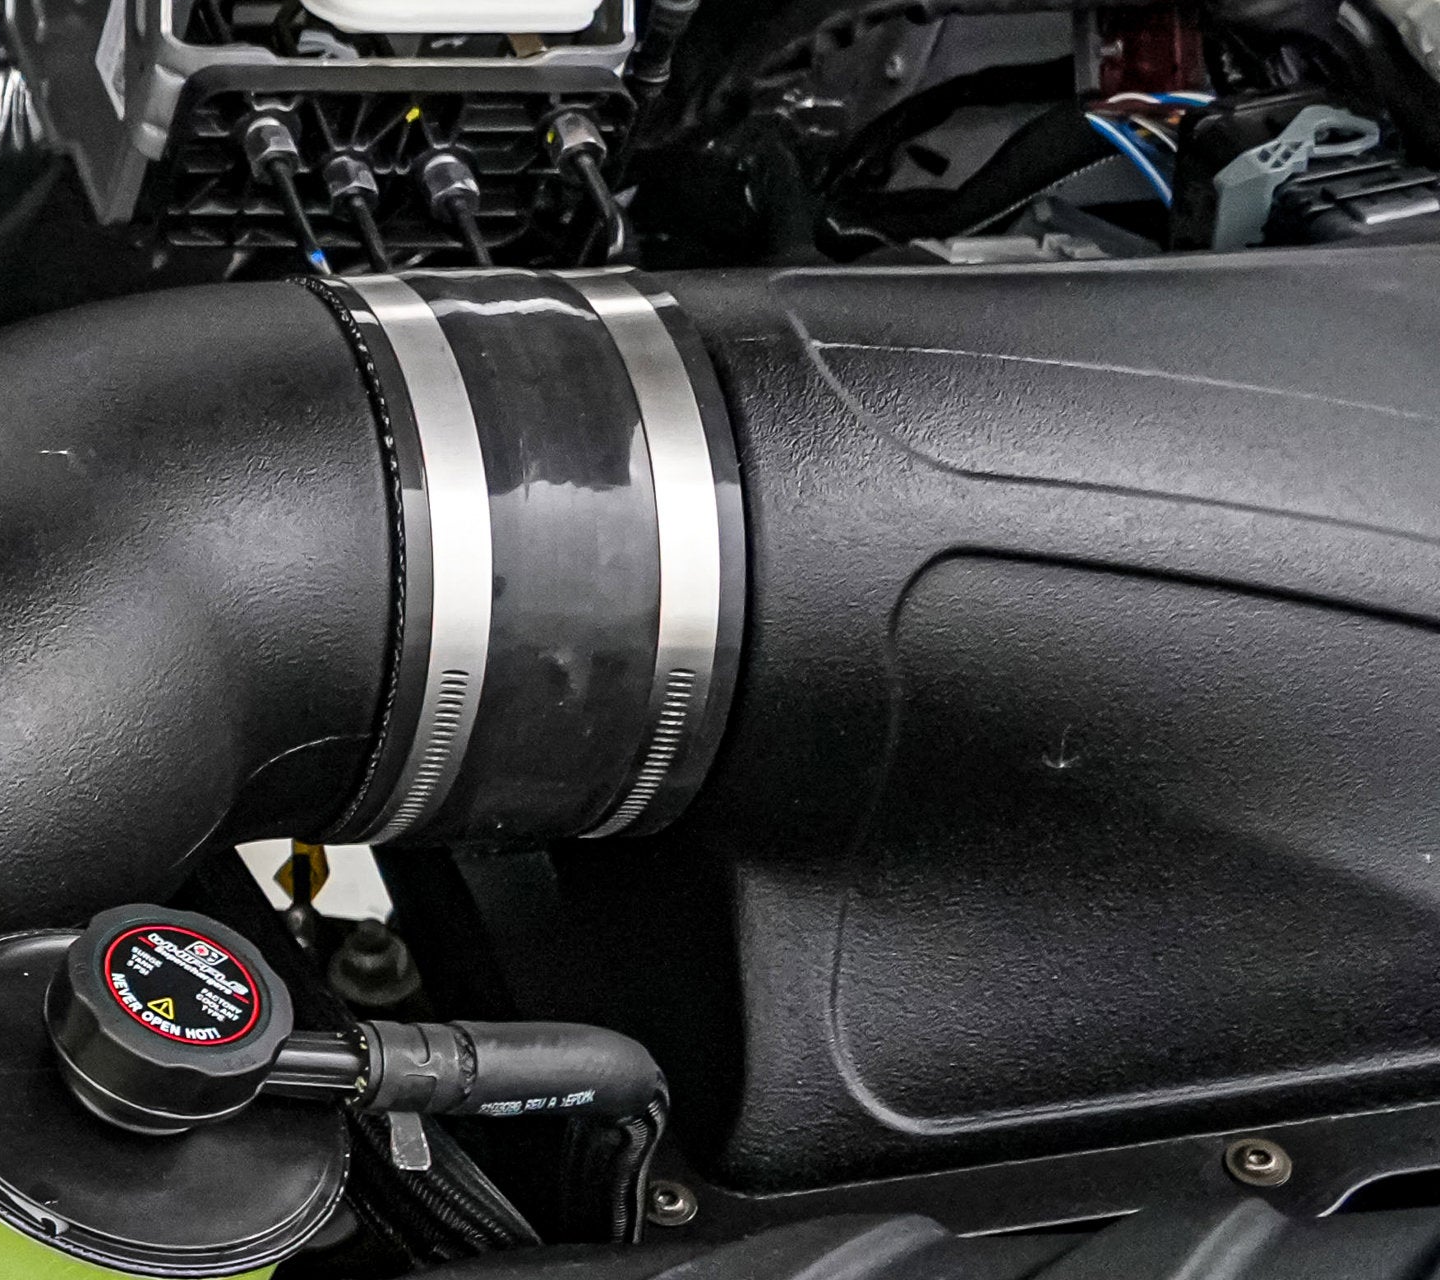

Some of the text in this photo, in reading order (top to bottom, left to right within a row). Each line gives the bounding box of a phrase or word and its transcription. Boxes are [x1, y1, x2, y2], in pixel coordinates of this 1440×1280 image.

[130, 945, 163, 968] SURGE
[130, 953, 155, 972] TANK
[147, 932, 249, 996] WHIPPLE
[134, 962, 151, 977] PSI
[111, 972, 222, 1041] NEVER OPEN HOT!
[195, 992, 240, 1022] COOLANT
[200, 987, 243, 1015] FACTORY
[200, 1003, 226, 1023] TYPE
[547, 1096, 557, 1109] A
